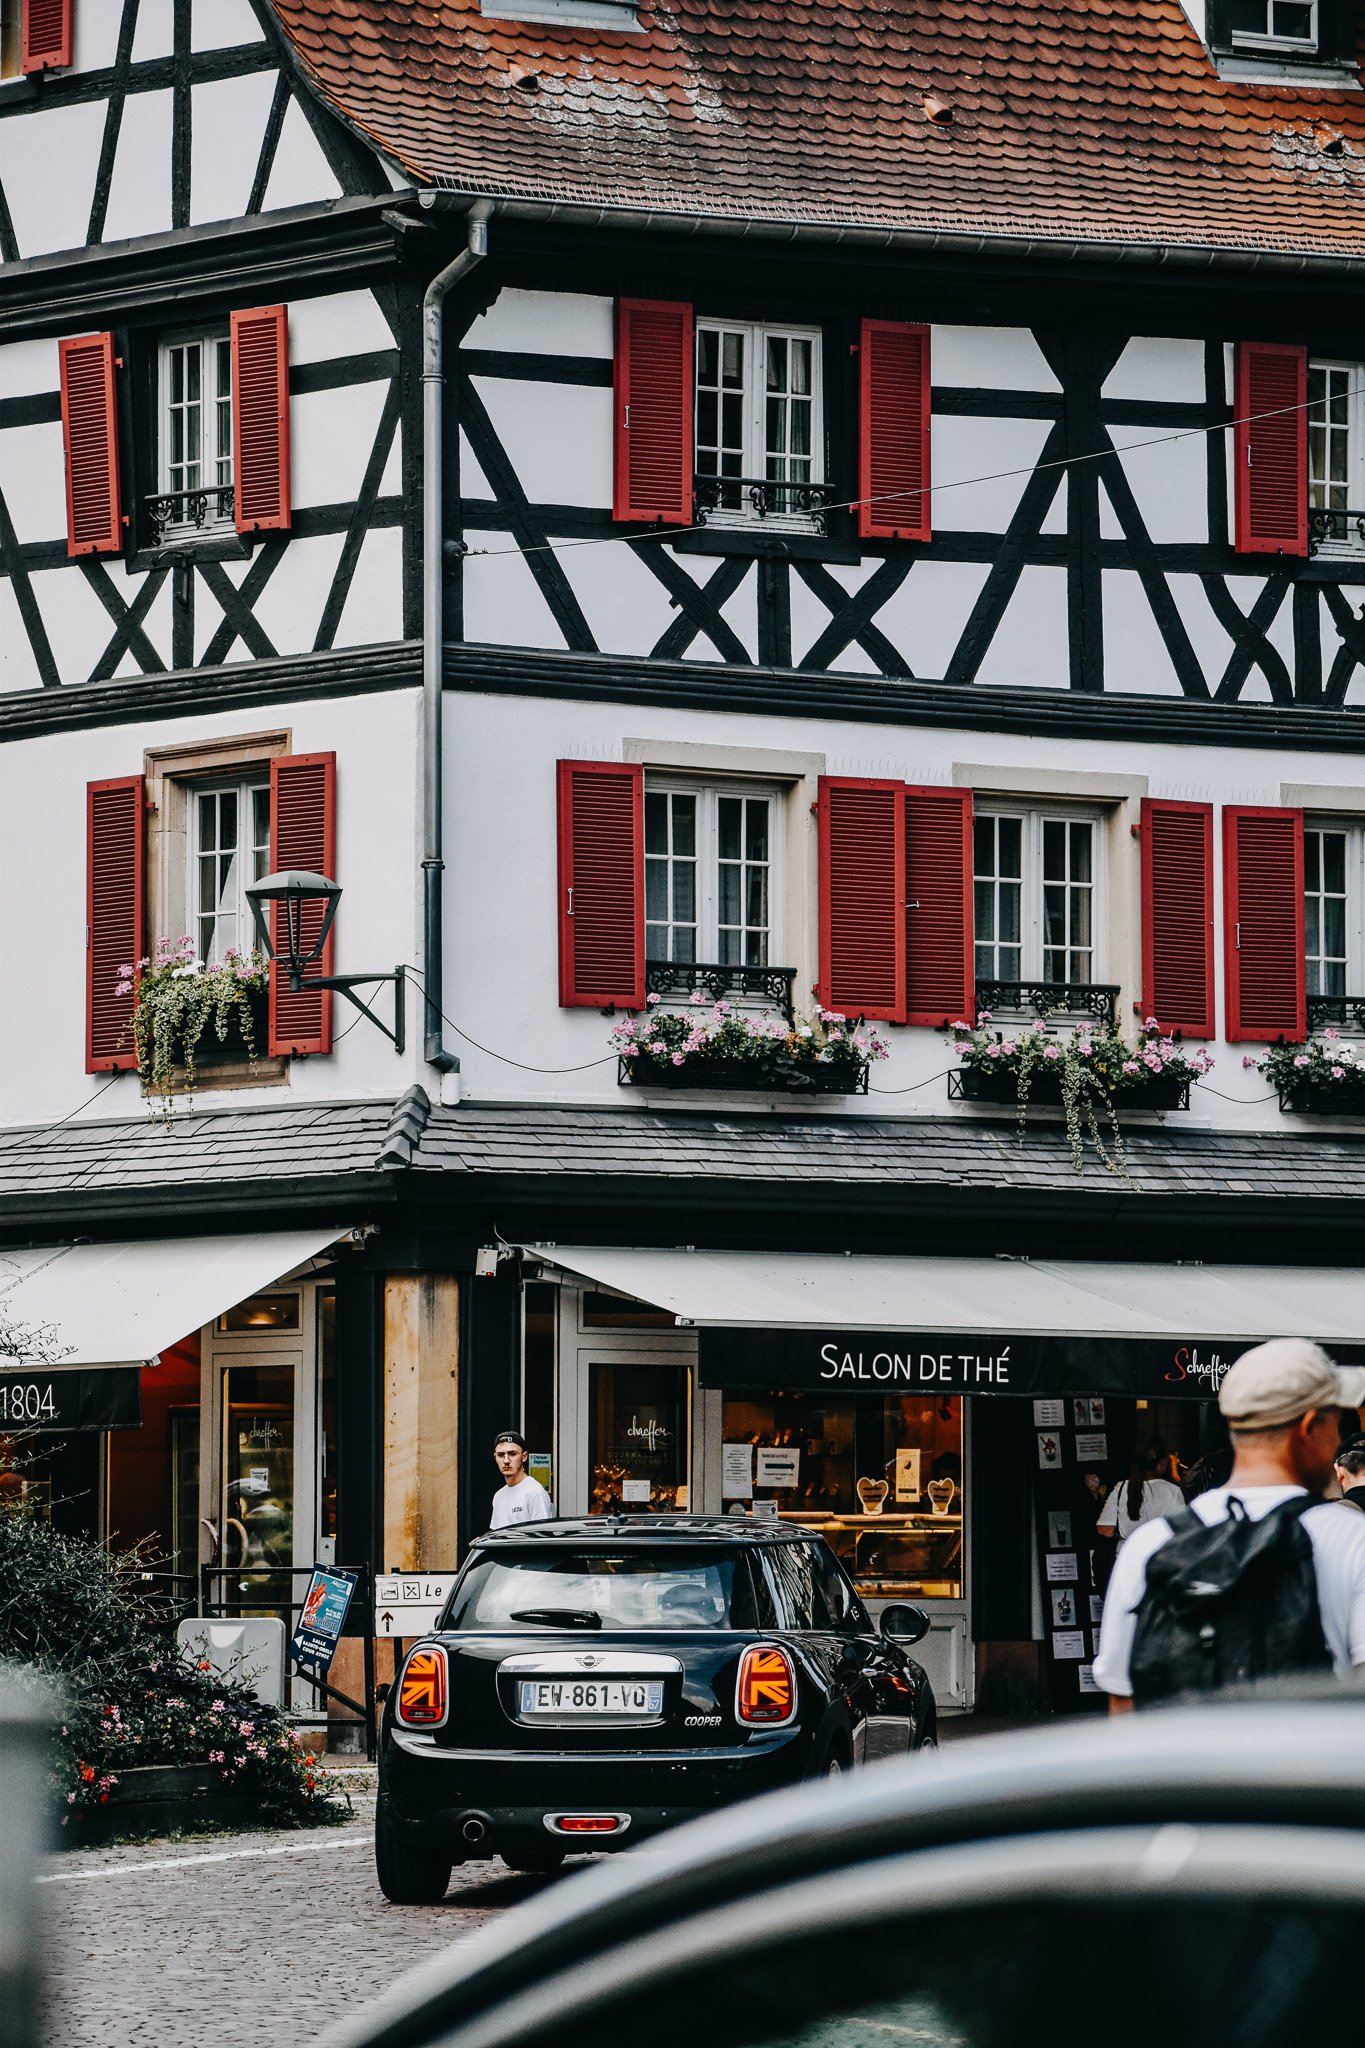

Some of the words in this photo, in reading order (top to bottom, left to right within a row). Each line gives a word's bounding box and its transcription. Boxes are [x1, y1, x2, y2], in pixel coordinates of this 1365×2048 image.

[820, 1343, 911, 1380] SALON
[919, 1354, 953, 1381] DE
[957, 1346, 1010, 1383] THÉ
[0, 1384, 55, 1420] 1804
[425, 1584, 442, 1597] Le
[649, 1698, 660, 1710] 67
[684, 1716, 722, 1727] COOPER
